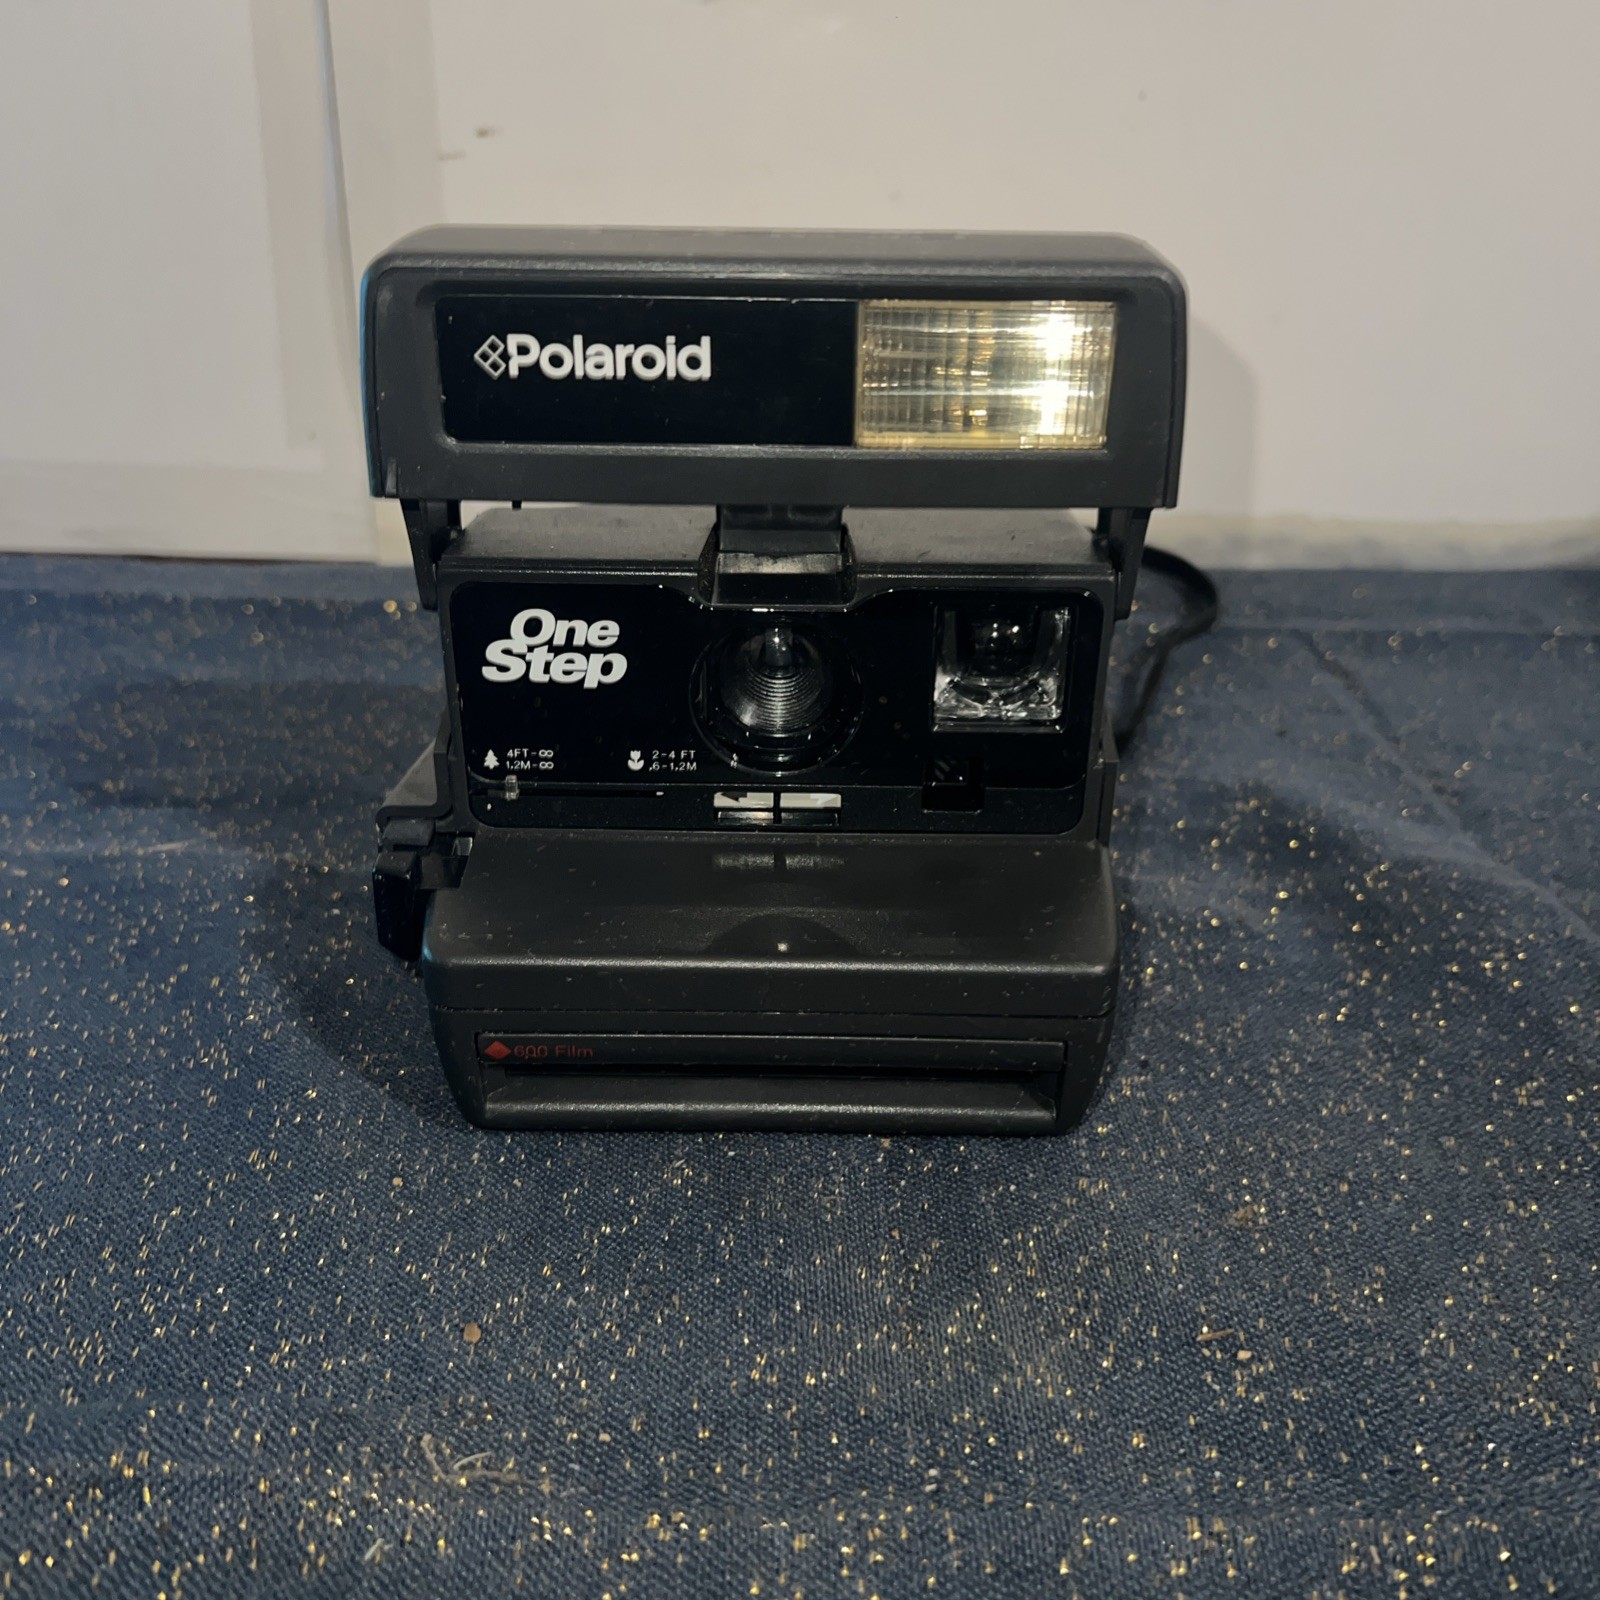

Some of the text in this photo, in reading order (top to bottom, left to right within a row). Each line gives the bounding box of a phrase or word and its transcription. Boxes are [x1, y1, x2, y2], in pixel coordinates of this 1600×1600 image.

[506, 333, 711, 381] Polaroid
[510, 608, 620, 648] One
[481, 639, 628, 689] Step
[554, 1044, 594, 1058] Film
